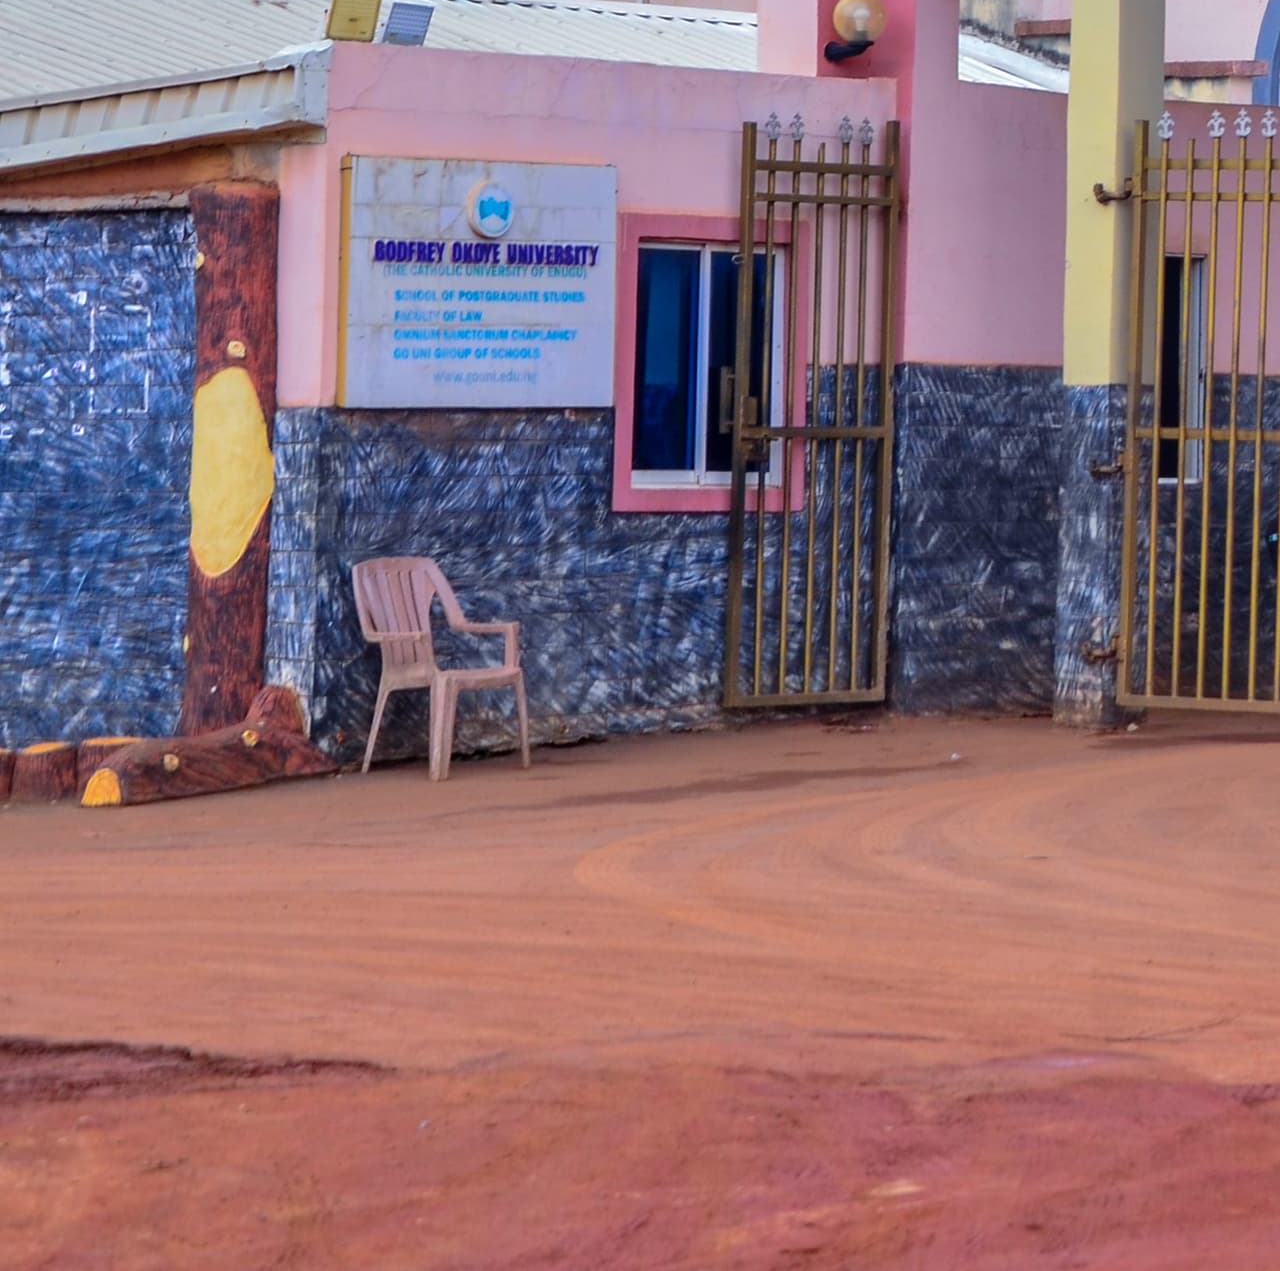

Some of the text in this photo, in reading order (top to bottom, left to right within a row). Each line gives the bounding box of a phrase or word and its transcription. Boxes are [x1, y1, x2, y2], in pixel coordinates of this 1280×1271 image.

[374, 240, 599, 267] GODFREY OKOYE UNIVERSITY
[410, 264, 462, 278] CATHOLIC
[466, 264, 527, 278] UNIVERSITY
[531, 266, 545, 278] OF
[395, 289, 585, 303] SCHOOL OF POSTGRADUATE STUDIES
[443, 310, 456, 322] OF
[460, 310, 483, 322] LAW
[393, 348, 541, 360] GO UNI GROUP OF SCHOOLS
